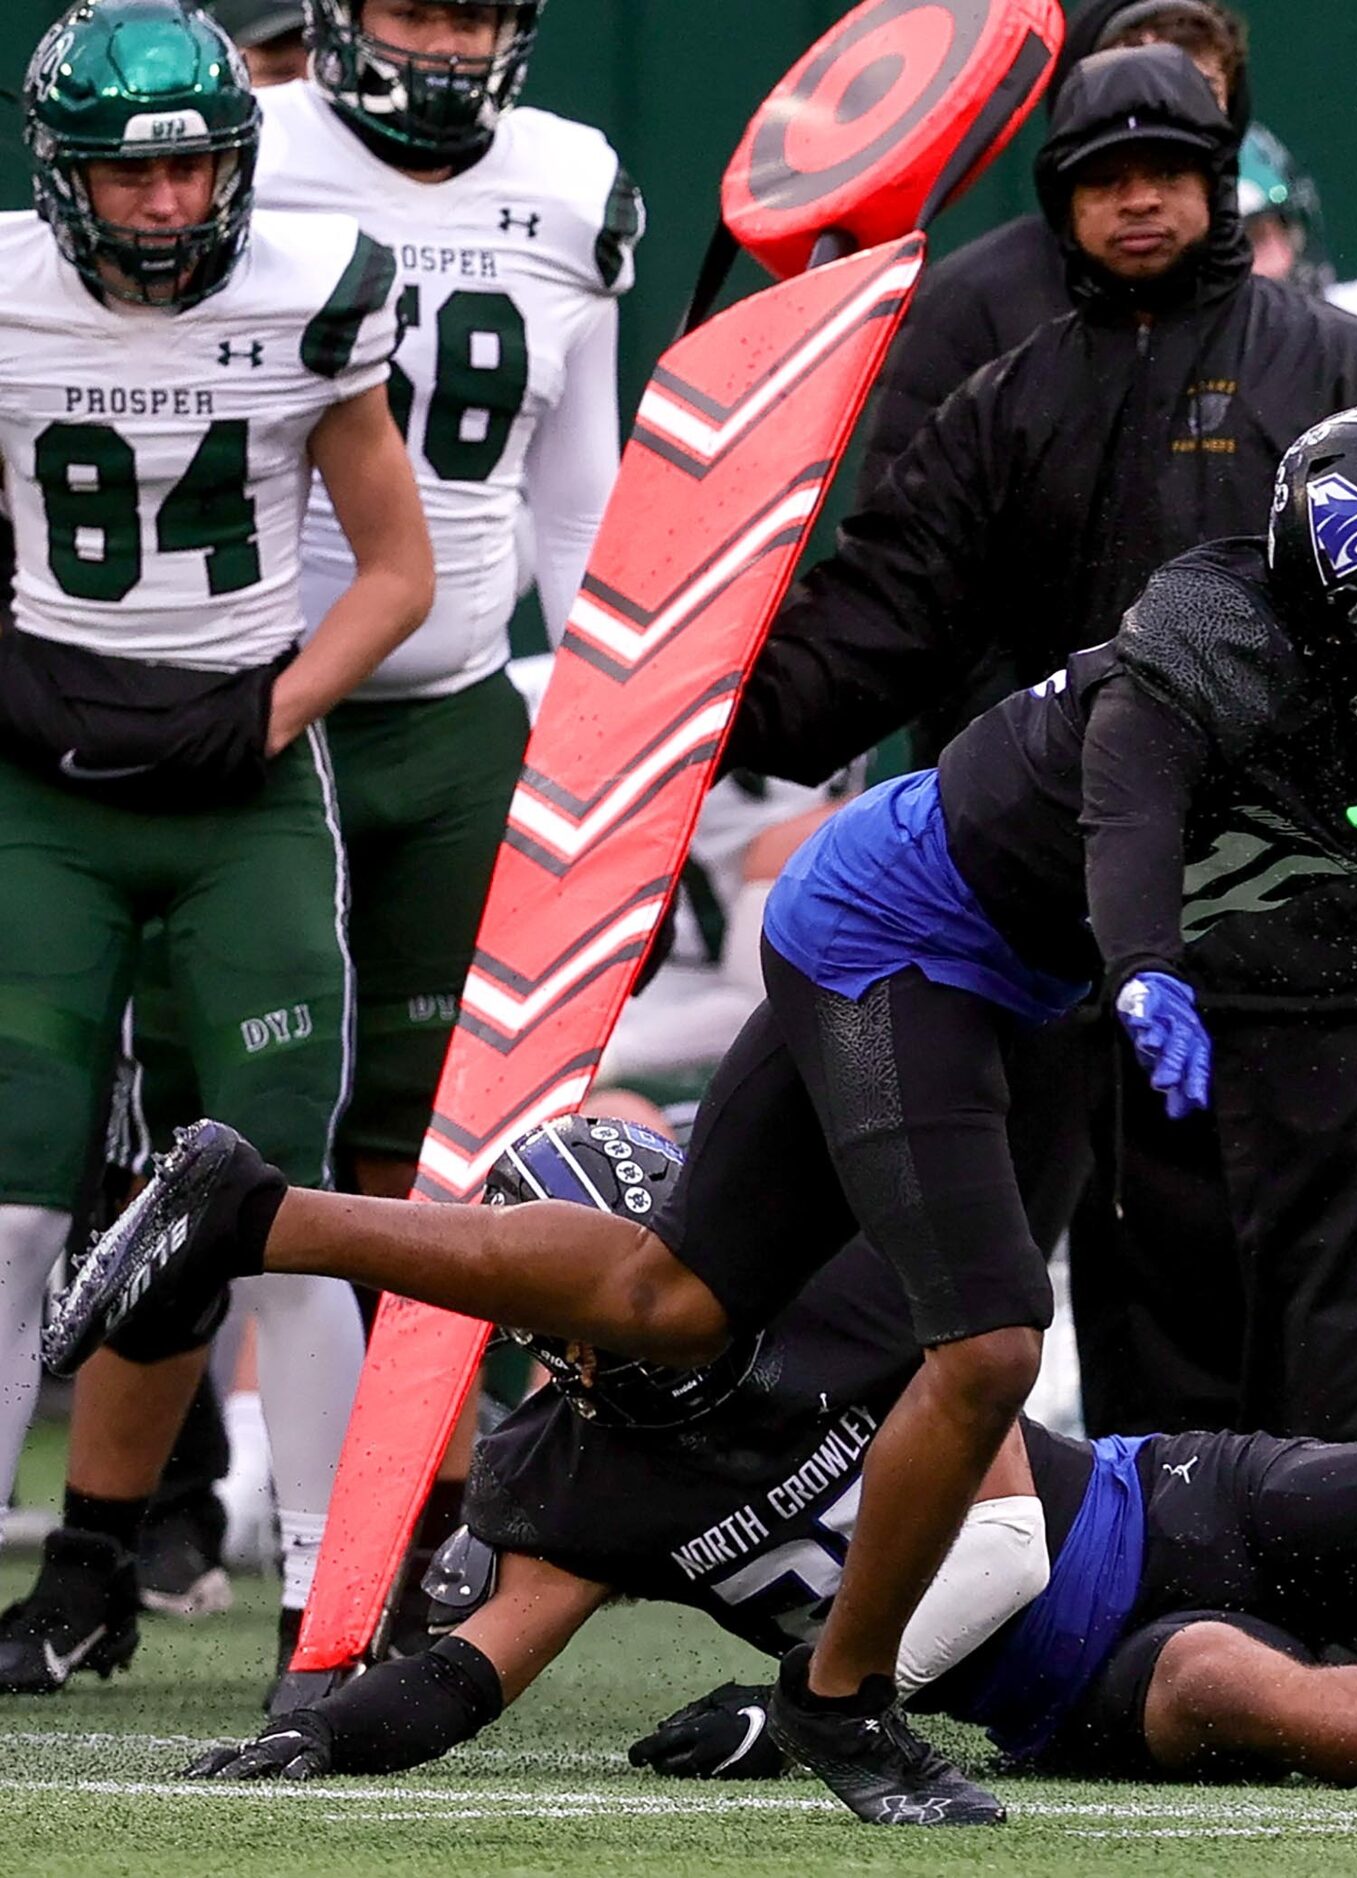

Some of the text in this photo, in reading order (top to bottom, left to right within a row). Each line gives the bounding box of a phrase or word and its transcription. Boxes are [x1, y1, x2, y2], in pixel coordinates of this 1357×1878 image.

[402, 245, 498, 277] OSPER
[66, 386, 214, 415] PROSPER
[386, 284, 528, 481] 8
[34, 418, 263, 603] 84
[240, 1003, 313, 1053] DYJ
[408, 994, 457, 1023] DY
[670, 1404, 877, 1581] NORTH CROWLEY
